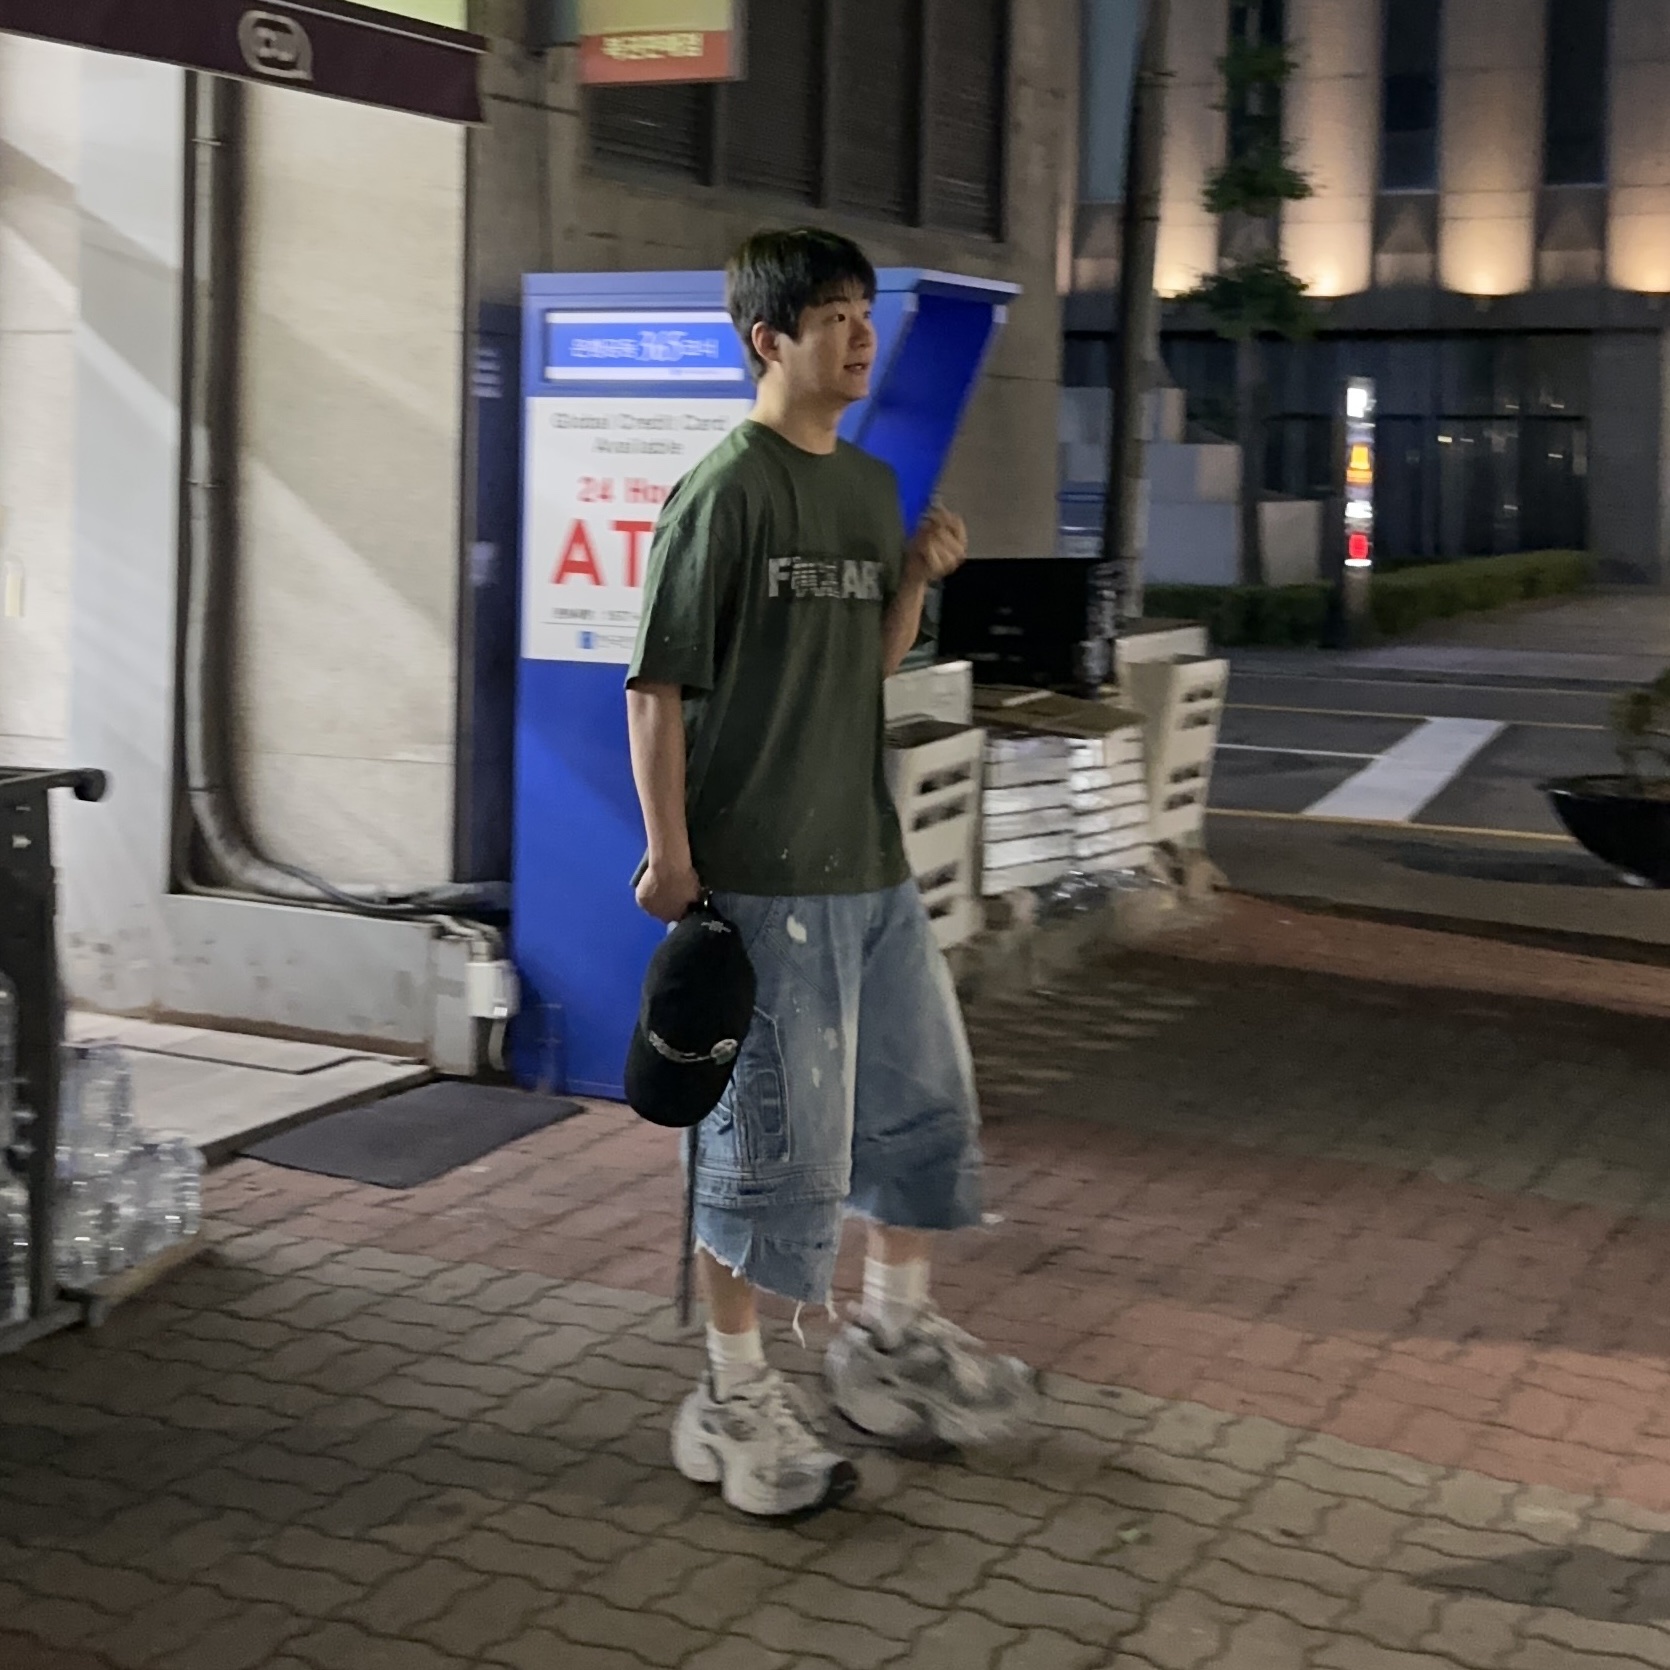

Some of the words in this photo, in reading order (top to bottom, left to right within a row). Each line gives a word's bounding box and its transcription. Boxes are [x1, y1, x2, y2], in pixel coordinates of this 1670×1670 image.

[577, 476, 615, 504] 24
[622, 476, 672, 504] Ho
[549, 518, 656, 588] AT
